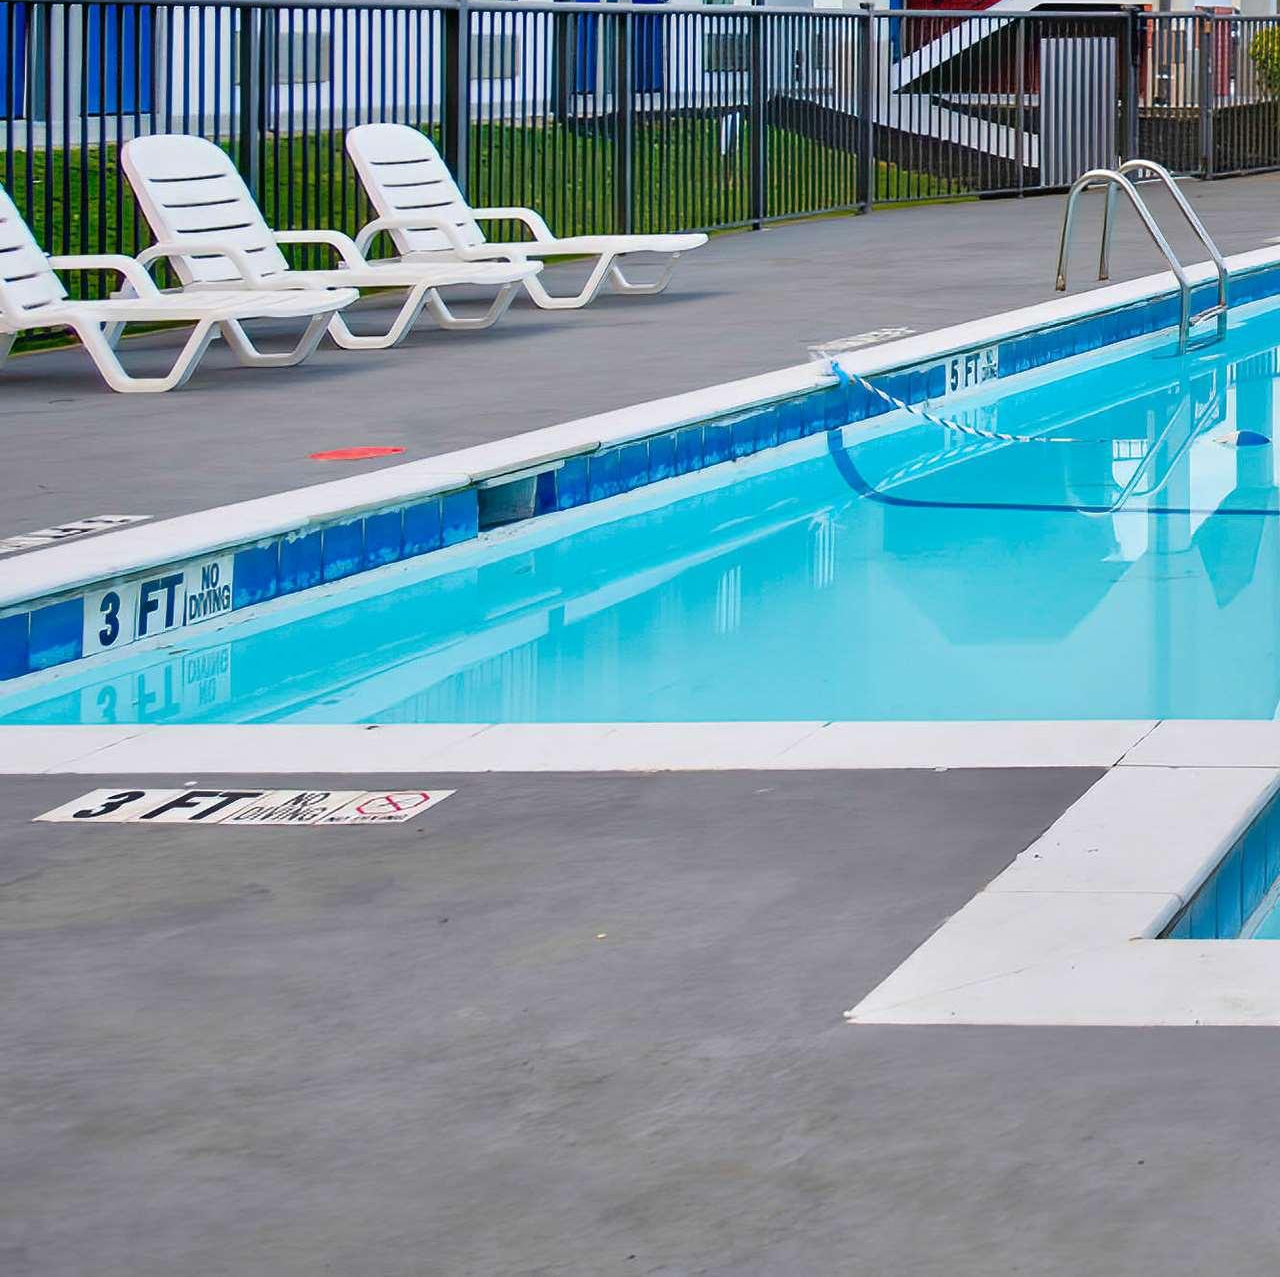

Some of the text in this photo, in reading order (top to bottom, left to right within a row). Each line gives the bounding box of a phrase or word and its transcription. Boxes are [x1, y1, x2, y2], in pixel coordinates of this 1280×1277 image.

[950, 359, 959, 392] 5
[964, 352, 981, 388] FT
[201, 562, 220, 591] NO
[99, 571, 184, 647] 3 FT
[188, 584, 231, 620] DIVING
[73, 790, 264, 821] 3 FT
[233, 806, 327, 821] DIVING
[291, 792, 331, 807] NO
